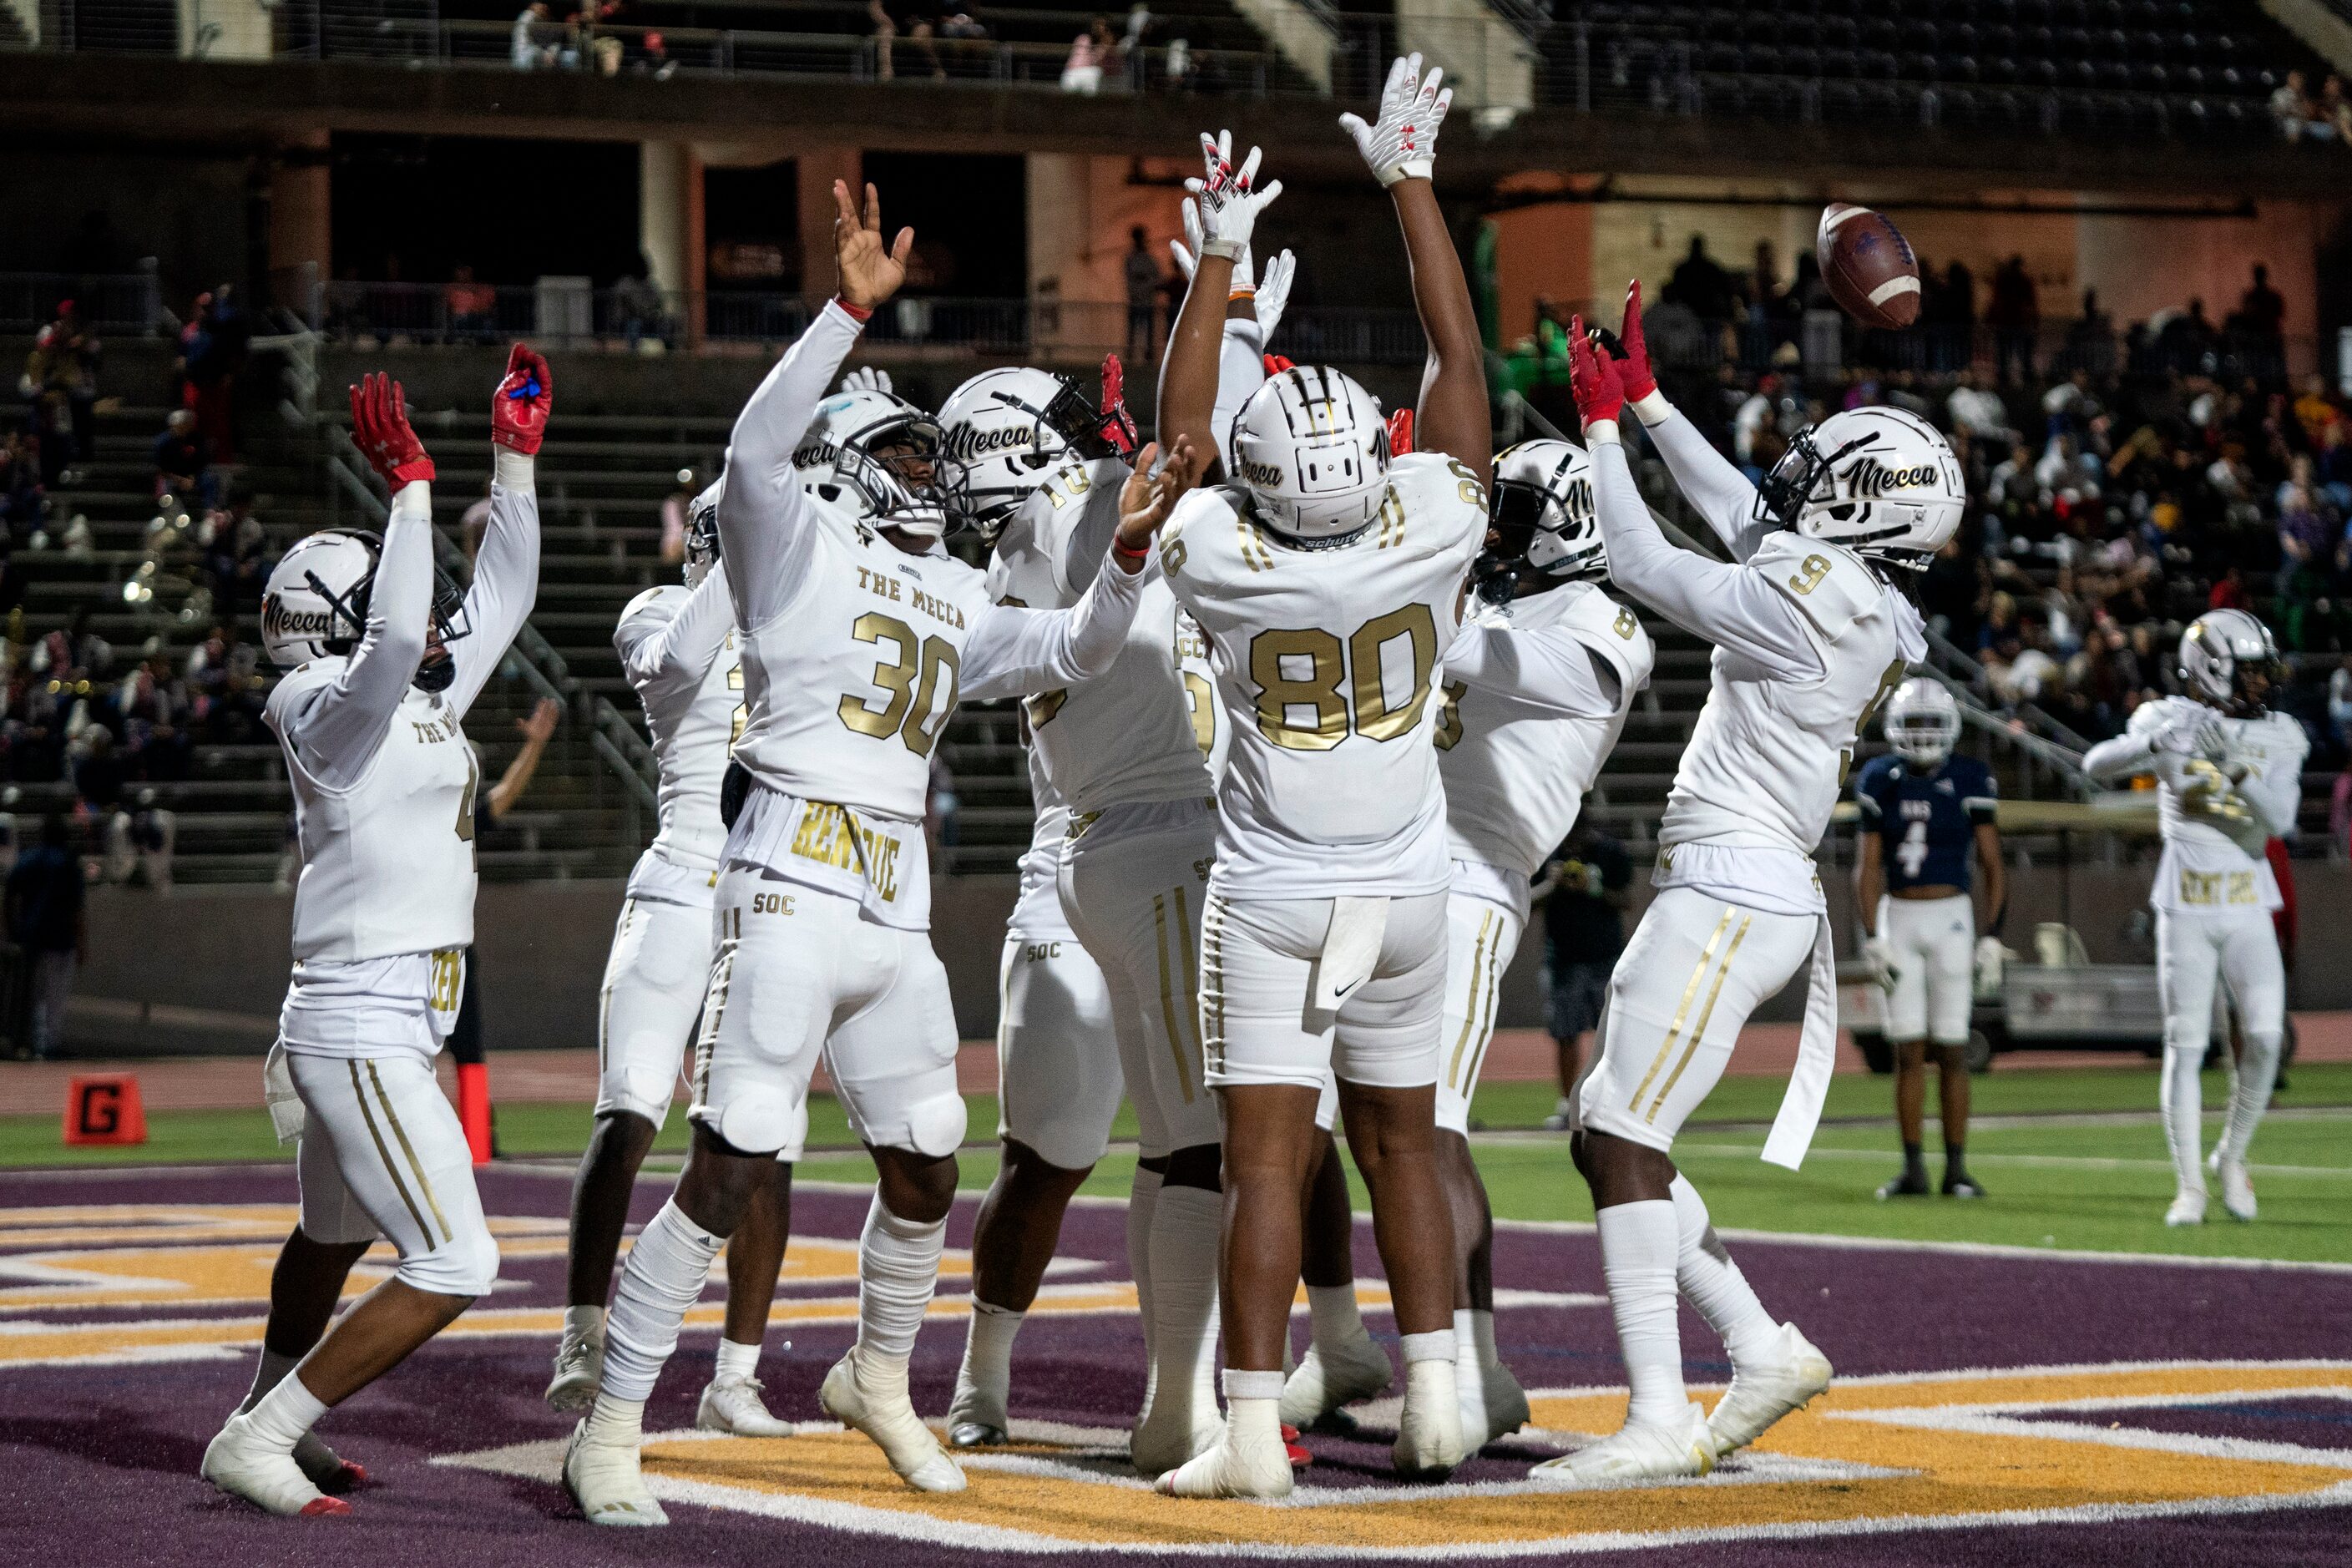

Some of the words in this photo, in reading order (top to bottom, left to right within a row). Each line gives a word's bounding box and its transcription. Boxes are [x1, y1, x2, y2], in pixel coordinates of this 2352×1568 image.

[791, 443, 838, 471] ecca
[946, 419, 1034, 463] Mecca
[1839, 457, 1939, 498] Mecca
[1789, 554, 1833, 595] 9
[261, 590, 332, 639] Mecca
[857, 565, 901, 601] THE
[912, 586, 965, 630] MECCA
[837, 610, 961, 760] 30
[1249, 602, 1438, 751] 80
[412, 721, 446, 744] THE
[1896, 821, 1929, 878] 4
[753, 893, 796, 916] SOC
[1026, 941, 1062, 963] SOC
[80, 1084, 120, 1134] G
